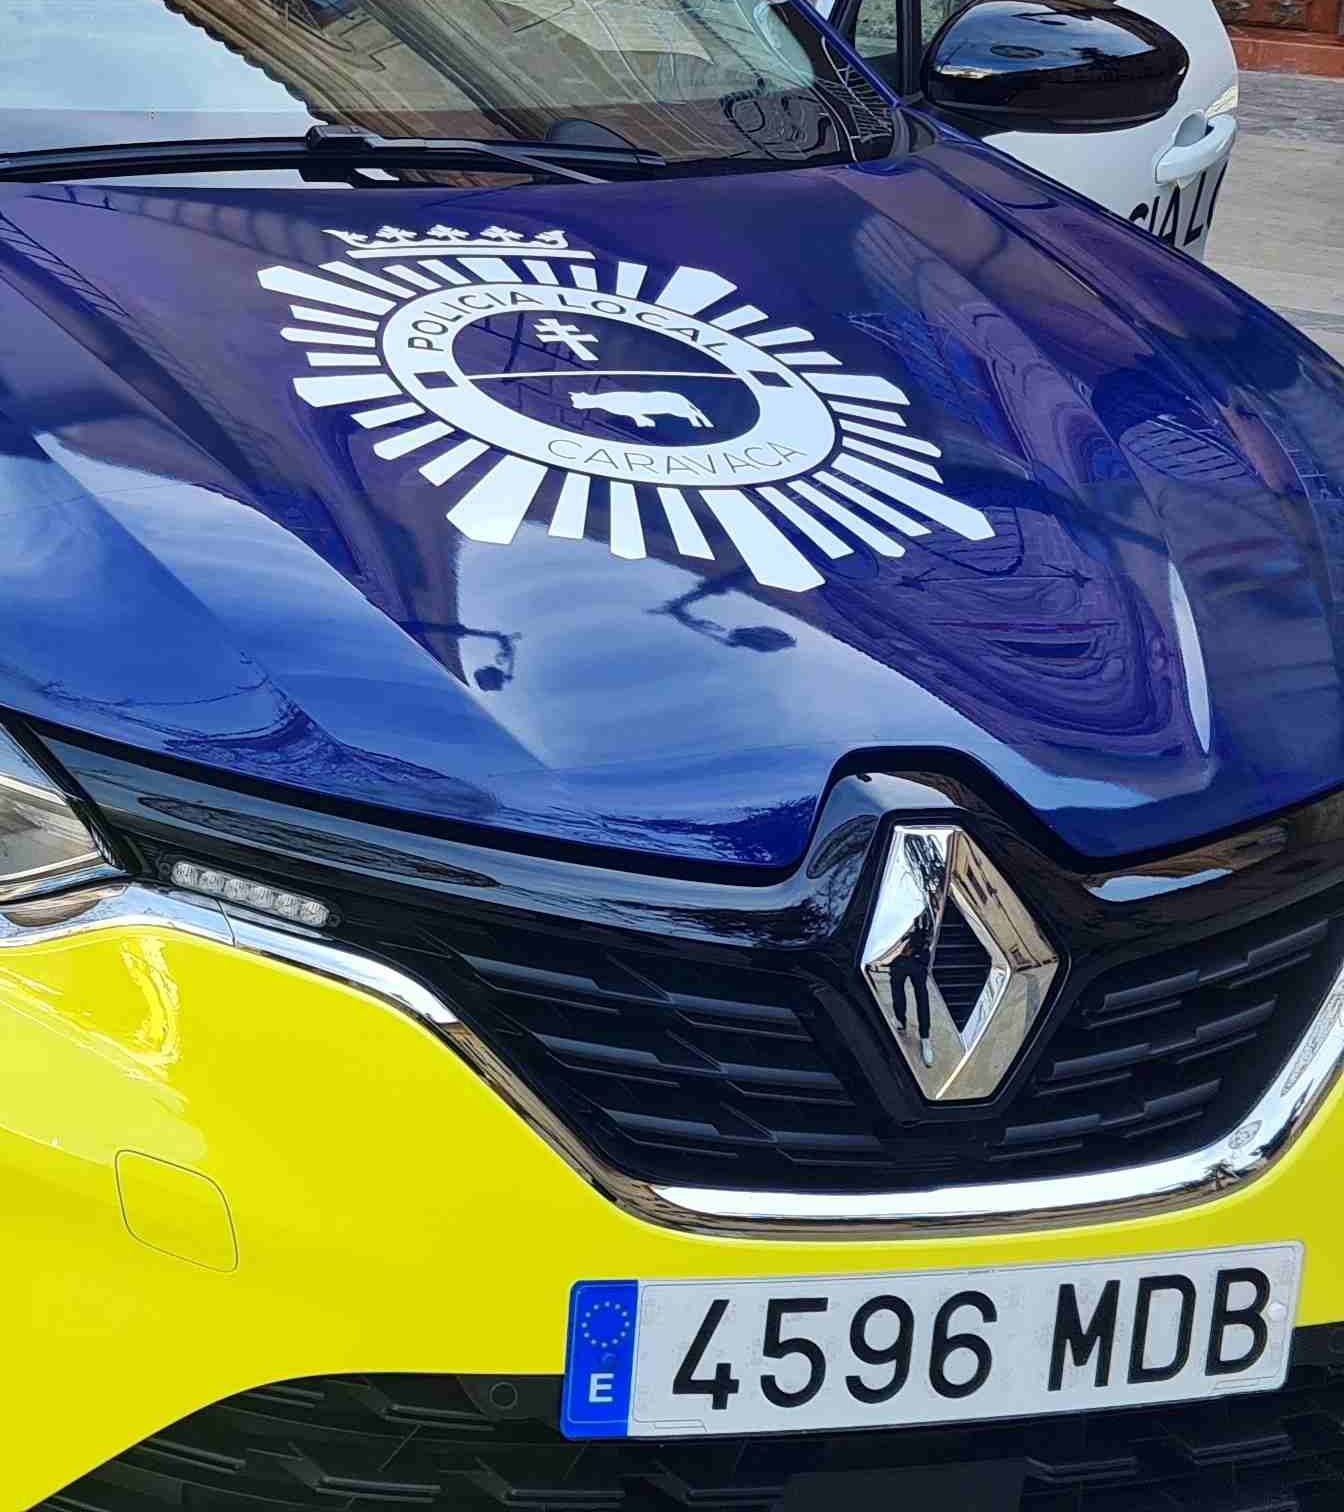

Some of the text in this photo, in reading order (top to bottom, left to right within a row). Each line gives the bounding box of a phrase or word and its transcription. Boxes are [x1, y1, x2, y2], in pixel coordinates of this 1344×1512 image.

[407, 290, 729, 356] POLICIA LOCAL
[547, 439, 808, 476] CARAVACA
[671, 1266, 1271, 1411] 4596 MDB
[589, 1372, 615, 1403] E
